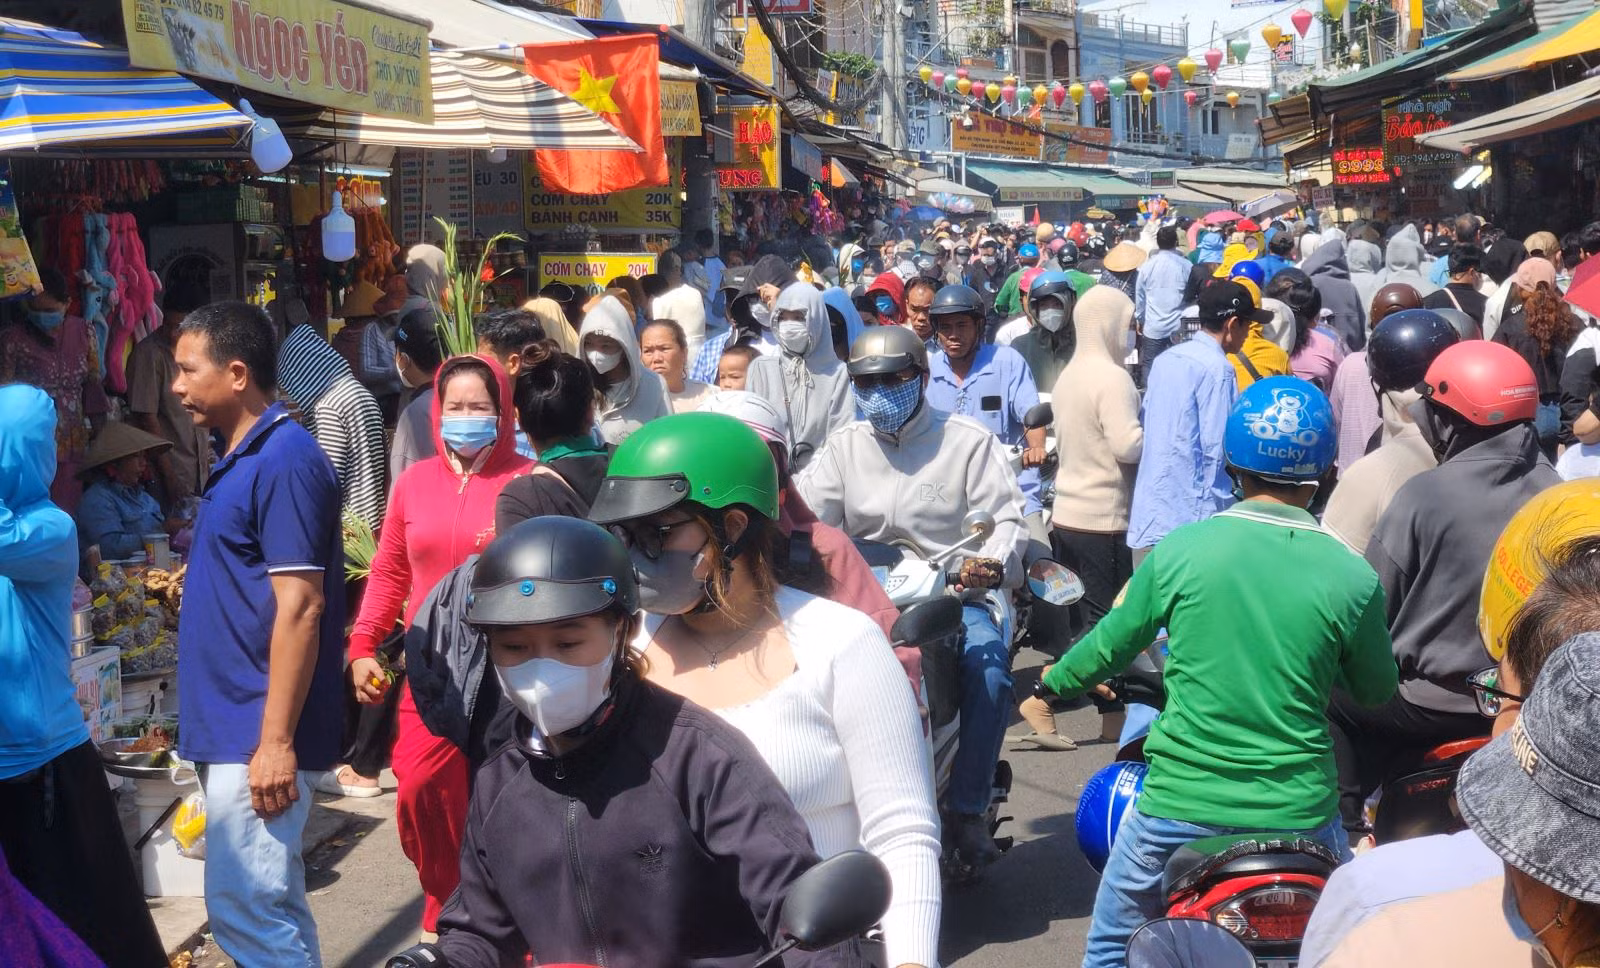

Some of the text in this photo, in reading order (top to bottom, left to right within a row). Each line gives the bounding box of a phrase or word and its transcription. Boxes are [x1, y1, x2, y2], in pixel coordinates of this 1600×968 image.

[231, 0, 368, 96] Ngọc Yến
[1339, 159, 1385, 174] 9999
[500, 171, 517, 185] 30
[645, 193, 672, 205] 20K
[578, 211, 619, 223] CANH
[645, 210, 672, 223] 35K
[544, 260, 648, 277] CƠM CHAY 20K
[1257, 441, 1306, 462] Lucky
